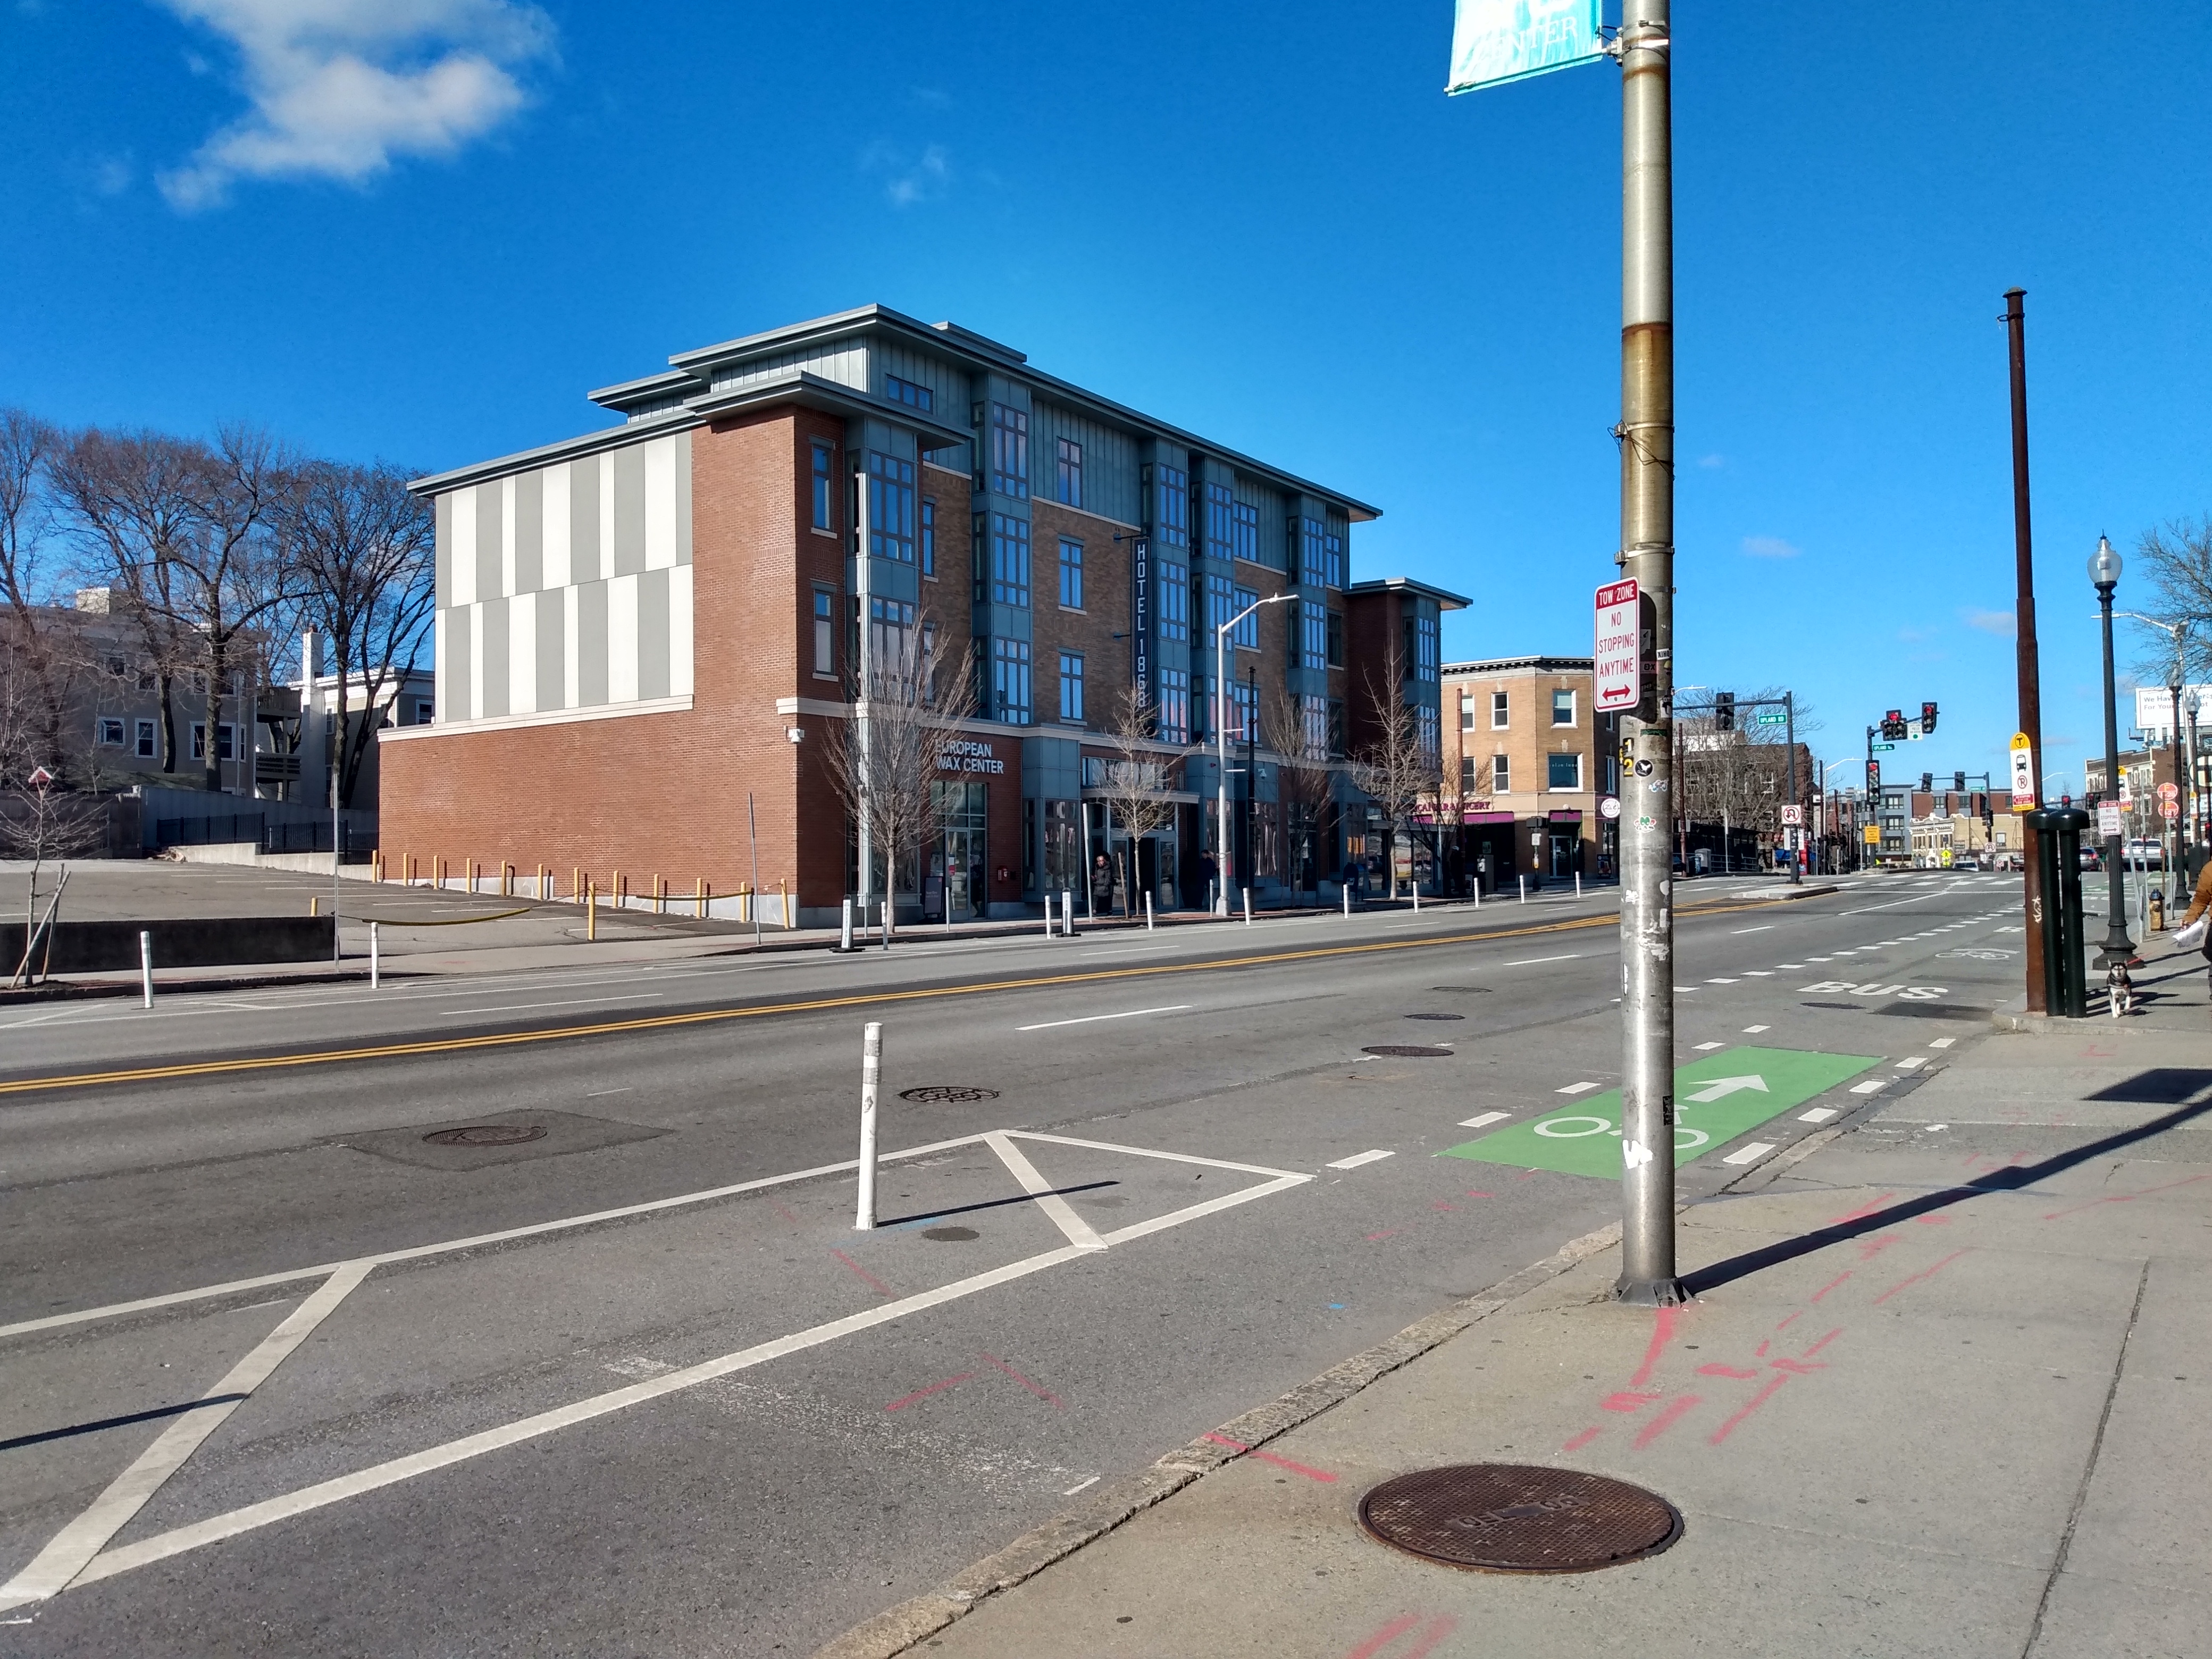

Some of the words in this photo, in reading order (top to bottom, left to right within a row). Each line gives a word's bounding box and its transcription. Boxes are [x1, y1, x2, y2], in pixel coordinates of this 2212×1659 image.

[1479, 16, 1578, 61] ENTER
[1137, 544, 1146, 631] HOTEL
[1599, 589, 1613, 606] TOW
[1616, 583, 1635, 601] ZONE
[1611, 611, 1621, 627] NO
[1599, 633, 1635, 654] STOPPING
[1599, 657, 1634, 678] ANYTIME
[935, 739, 992, 757] EUROPEAN
[936, 756, 961, 770] WAX
[963, 758, 1004, 774] CENTER
[1796, 981, 1948, 999] BUS
